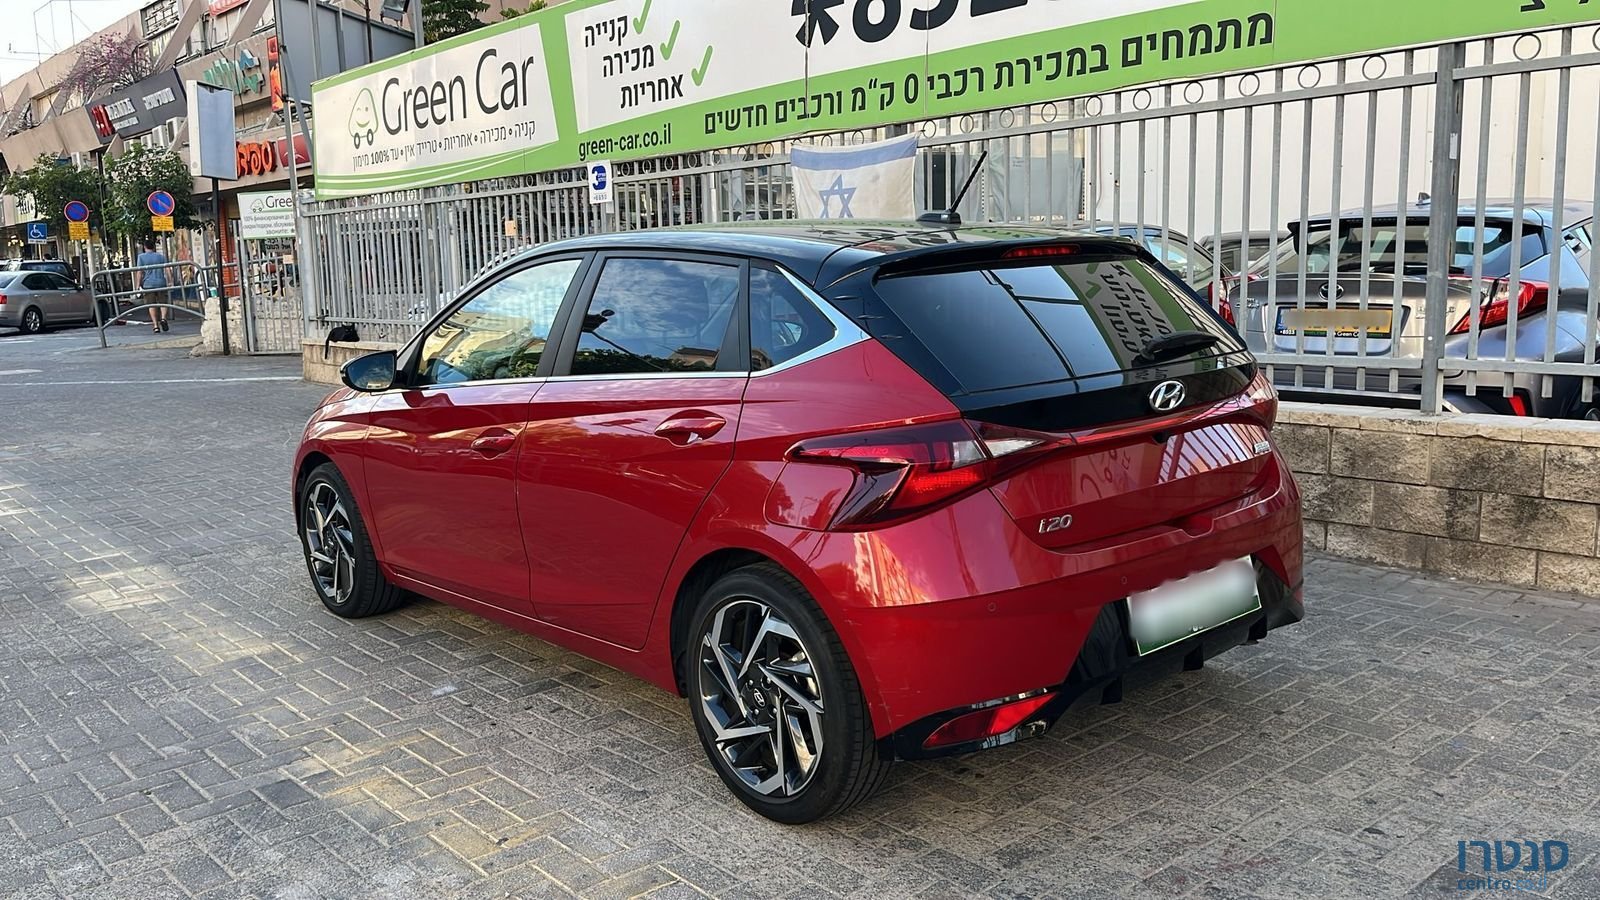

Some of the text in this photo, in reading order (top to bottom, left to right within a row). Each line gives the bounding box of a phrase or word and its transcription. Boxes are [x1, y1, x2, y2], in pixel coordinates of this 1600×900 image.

[584, 16, 628, 48] קנייה
[1121, 12, 1274, 68] מתמחים
[602, 44, 655, 78] מכירה
[993, 43, 1109, 90] במכירת
[382, 48, 535, 136] Green Car
[620, 73, 684, 109] אחריות
[904, 72, 919, 104] 0
[926, 66, 984, 100] רכבי
[704, 103, 768, 135] חדשים
[775, 90, 843, 124] ורכבים
[443, 132, 473, 151] אחריות
[479, 125, 507, 144] מכירה
[514, 120, 537, 140] קניה
[578, 122, 672, 162] green-car.co.il
[370, 150, 390, 165] 100%
[266, 196, 292, 208] Gree
[1038, 513, 1073, 534] i20
